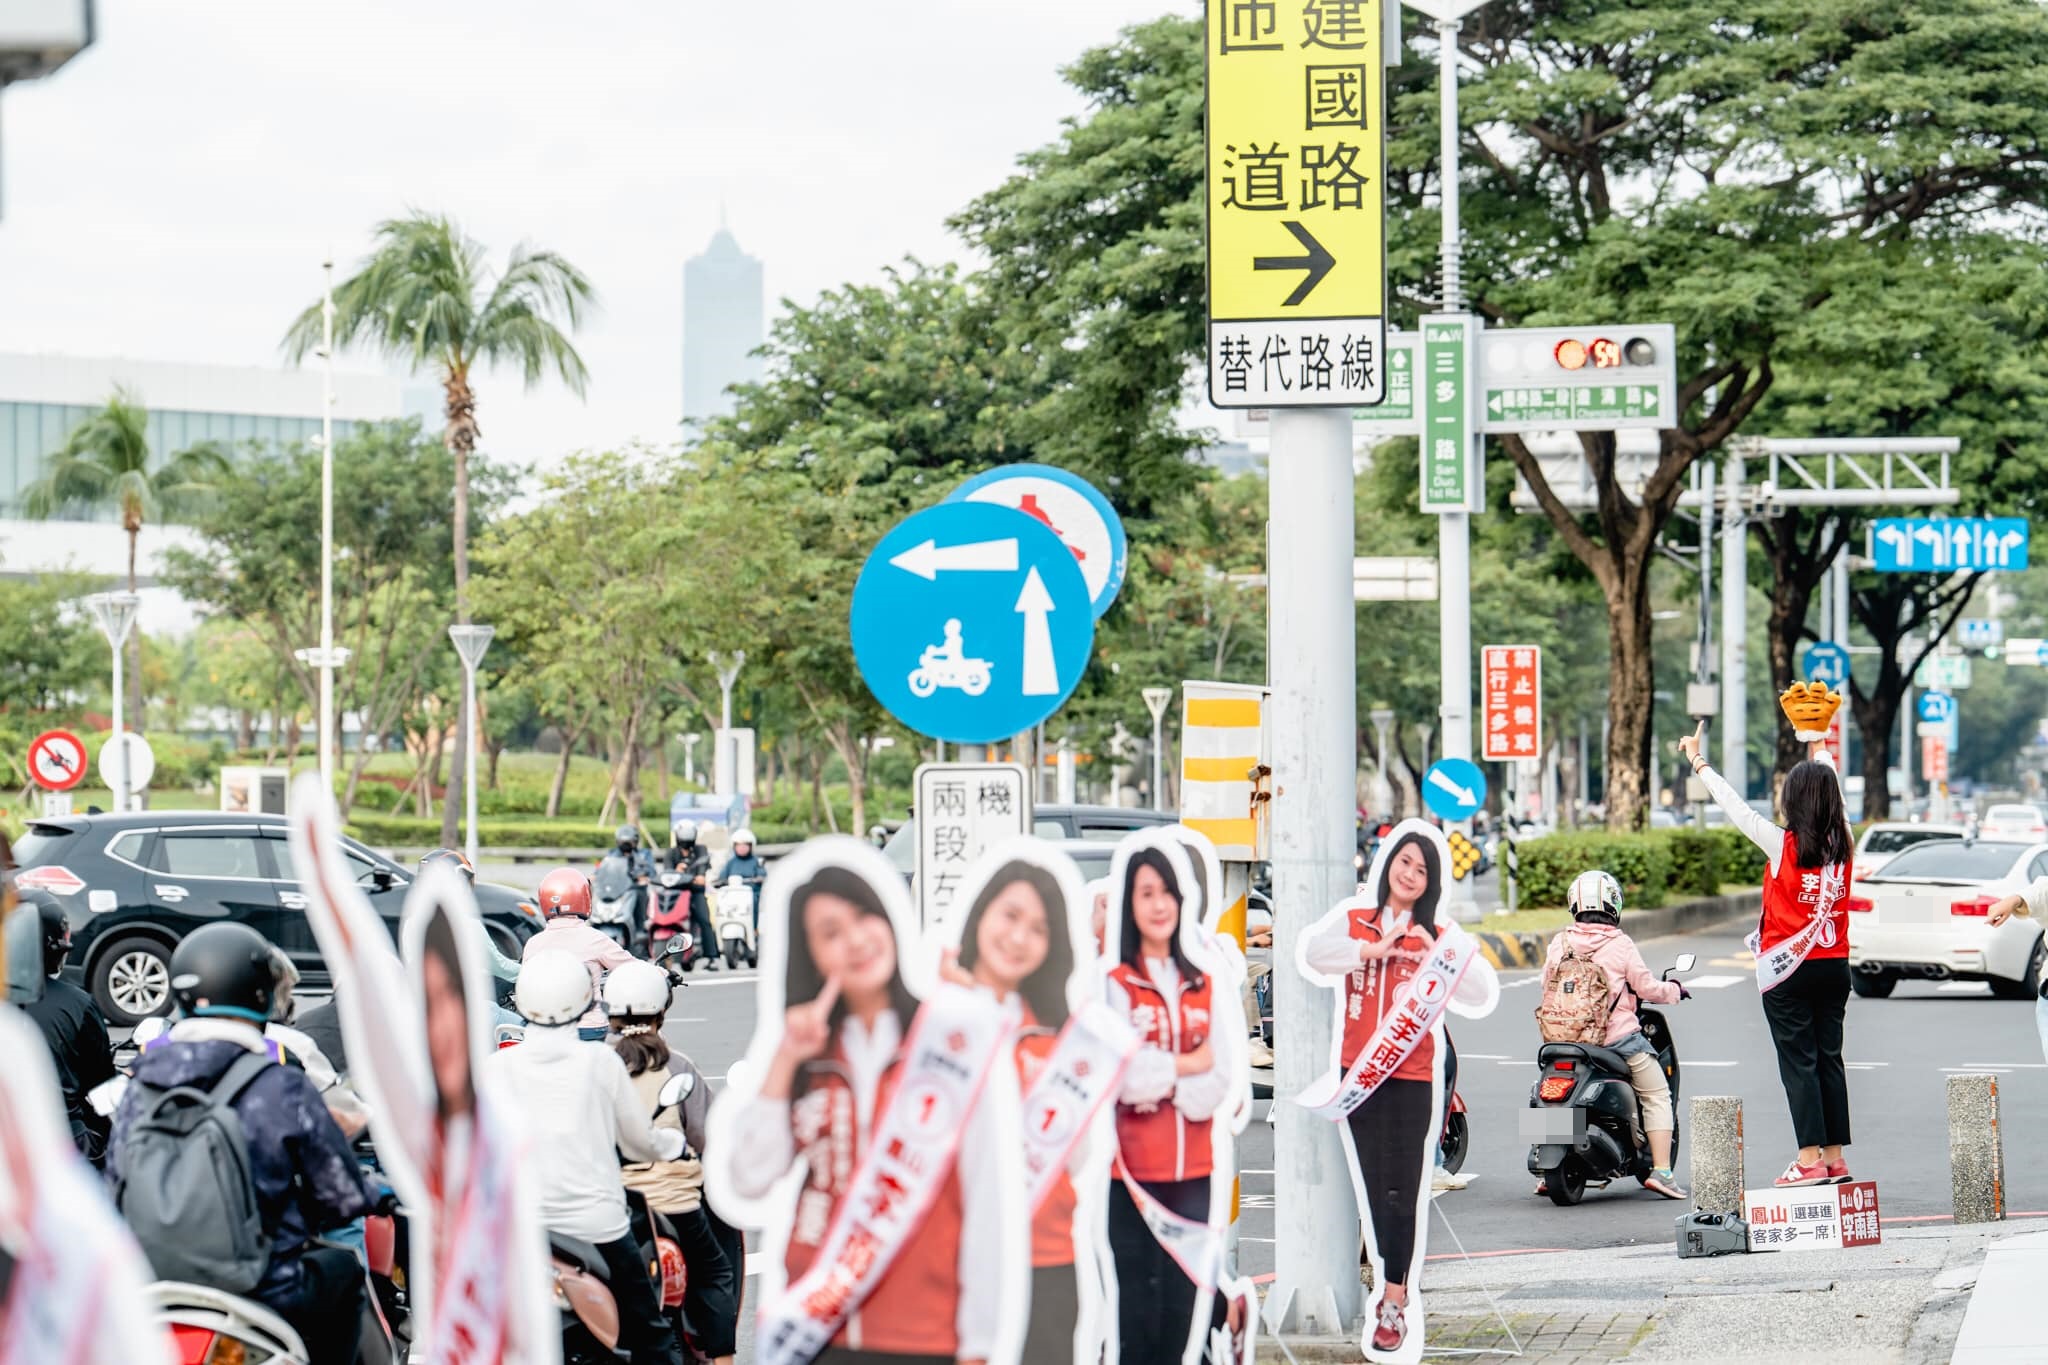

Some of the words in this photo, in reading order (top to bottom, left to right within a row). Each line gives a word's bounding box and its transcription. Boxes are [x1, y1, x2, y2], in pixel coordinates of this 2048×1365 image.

[1299, 0, 1370, 211] 建國路
[1219, 333, 1376, 393] 替代路線
[933, 780, 967, 923] 兩段左
[1426, 980, 1437, 996] 1
[1751, 1206, 1788, 1225] 鳳山
[1752, 1224, 1837, 1244] 客家多一席!
